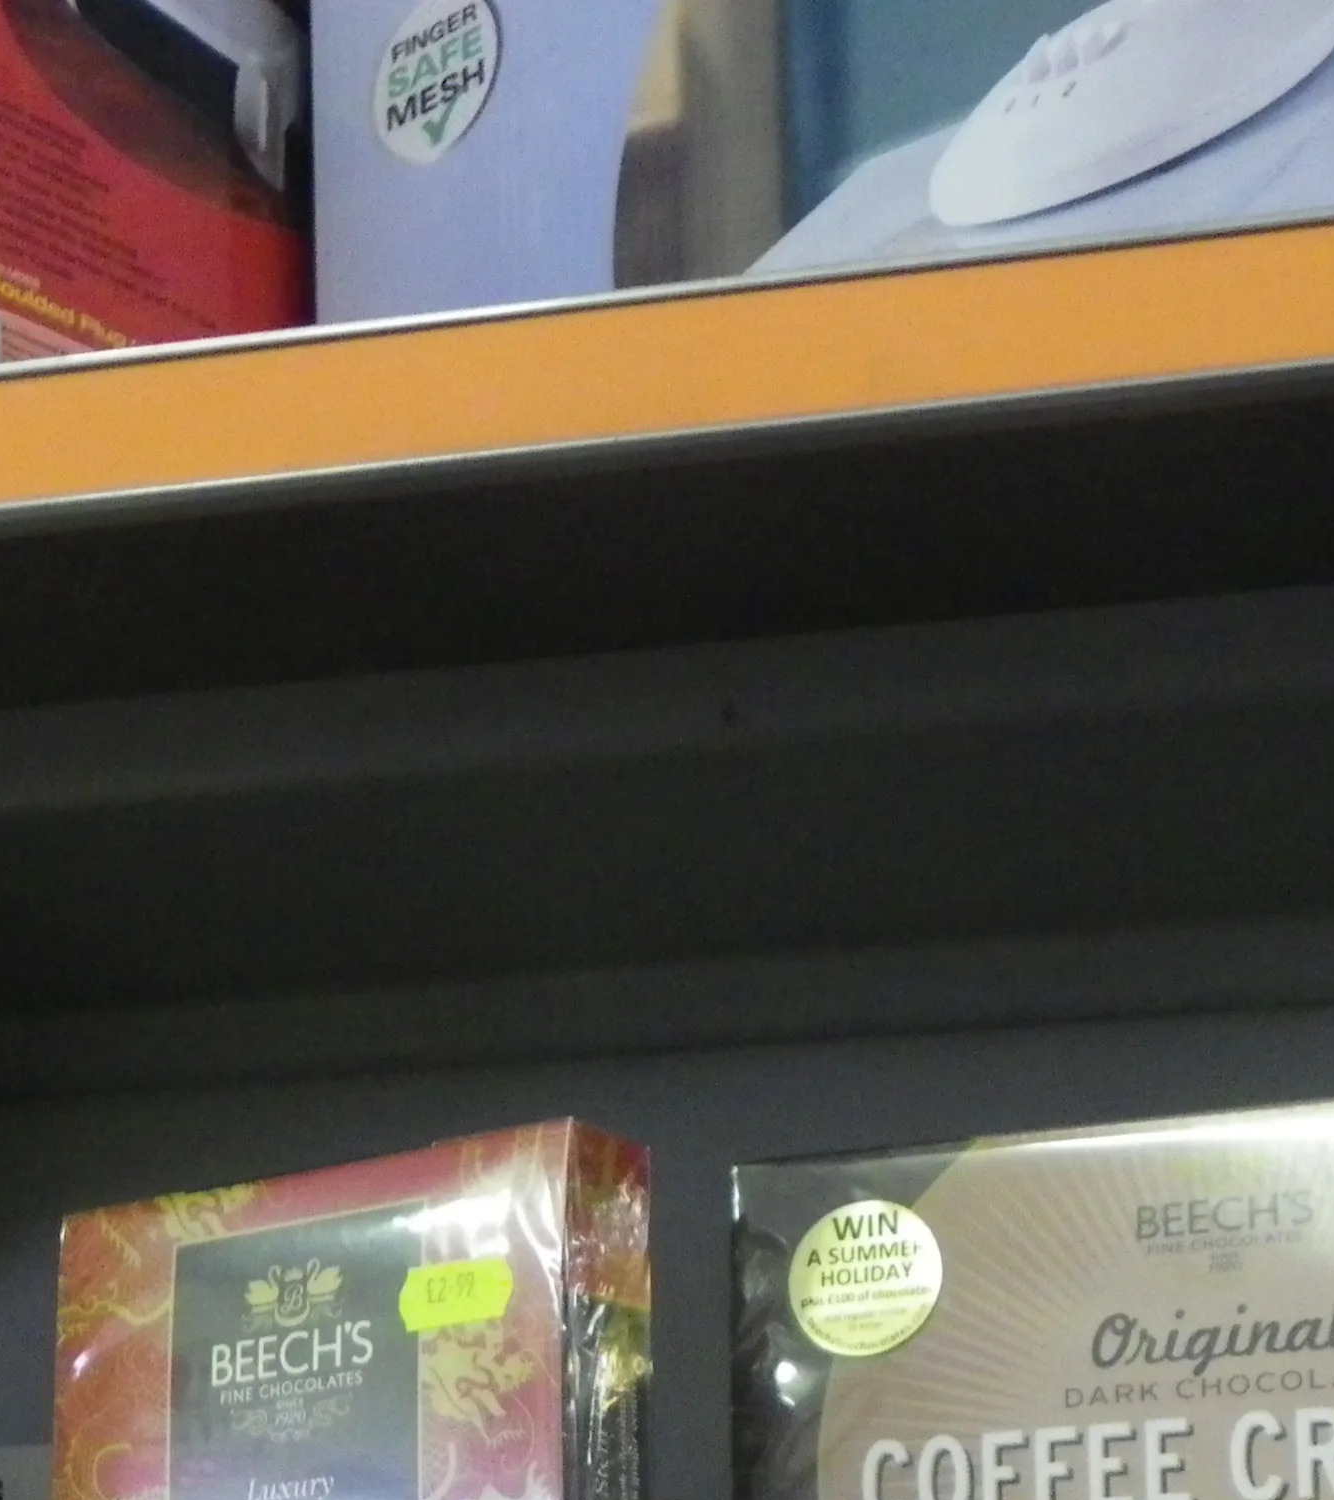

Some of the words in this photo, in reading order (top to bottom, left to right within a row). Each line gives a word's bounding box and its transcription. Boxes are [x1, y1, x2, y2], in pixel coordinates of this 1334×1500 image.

[392, 3, 476, 63] FINGER
[388, 25, 483, 98] SAFE
[387, 58, 485, 132] MESH
[832, 1210, 898, 1241] WIN
[807, 1250, 822, 1267] A
[821, 1261, 913, 1287] HOLIDAY
[211, 1320, 374, 1387] BEECH'S
[220, 1386, 252, 1405] FINE
[259, 1371, 363, 1398] CHOCOLATES
[1064, 1381, 1159, 1409] DARK
